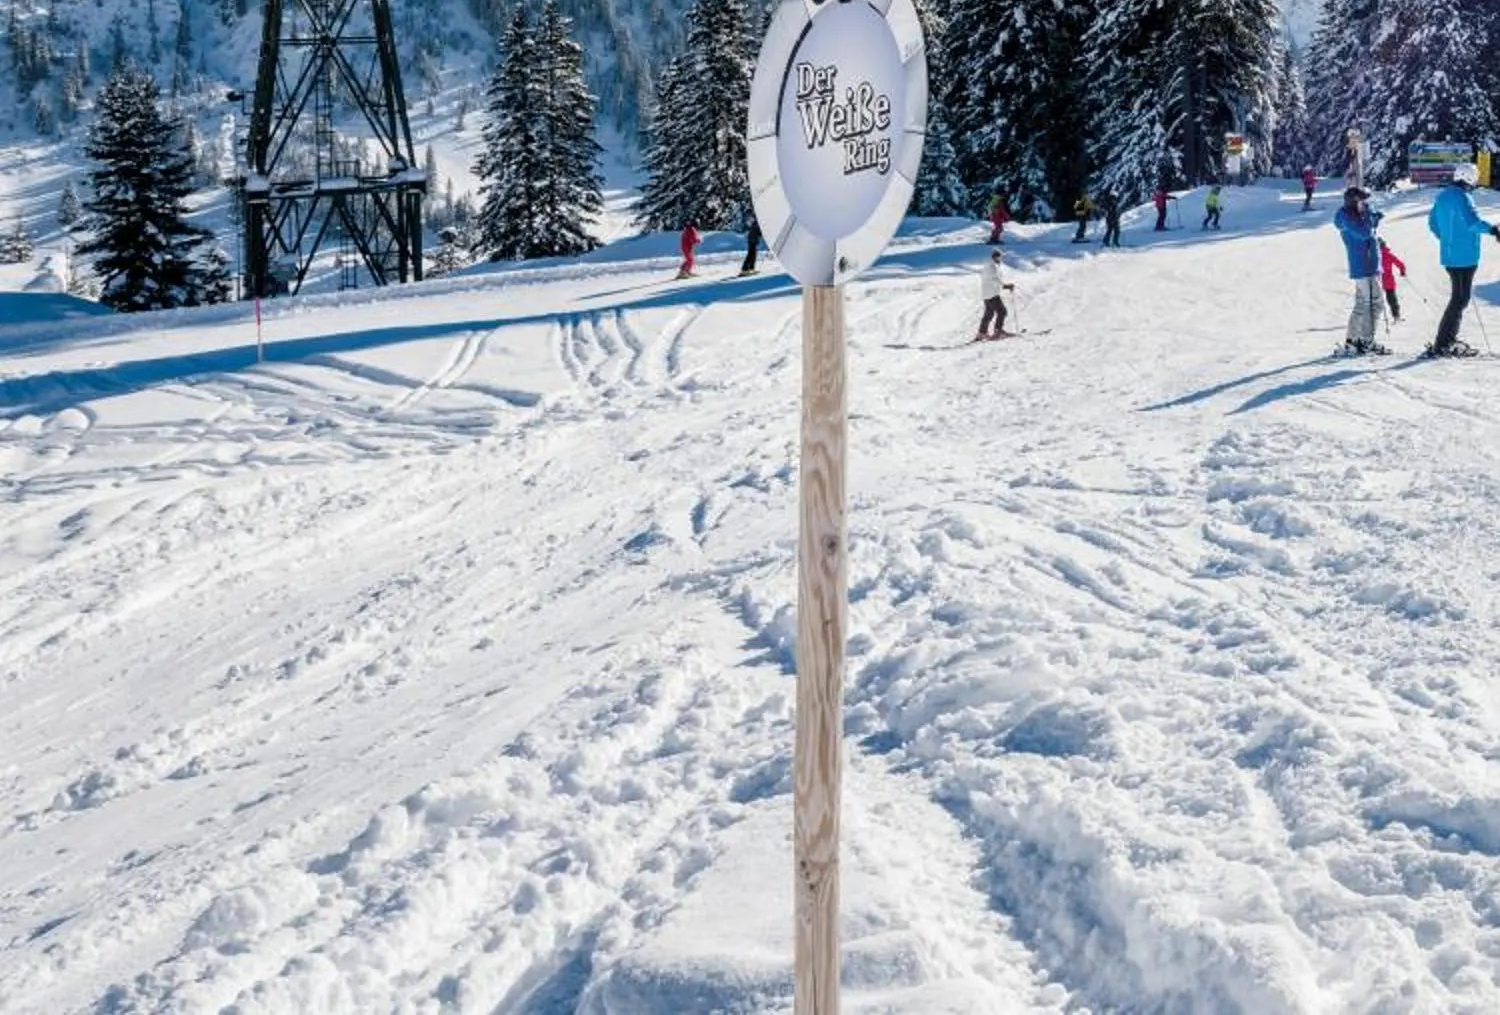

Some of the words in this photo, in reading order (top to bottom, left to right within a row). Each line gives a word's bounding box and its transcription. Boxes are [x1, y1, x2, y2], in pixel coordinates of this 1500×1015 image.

[797, 63, 838, 99] Der
[797, 82, 891, 149] Weiße
[843, 137, 891, 176] Ring
